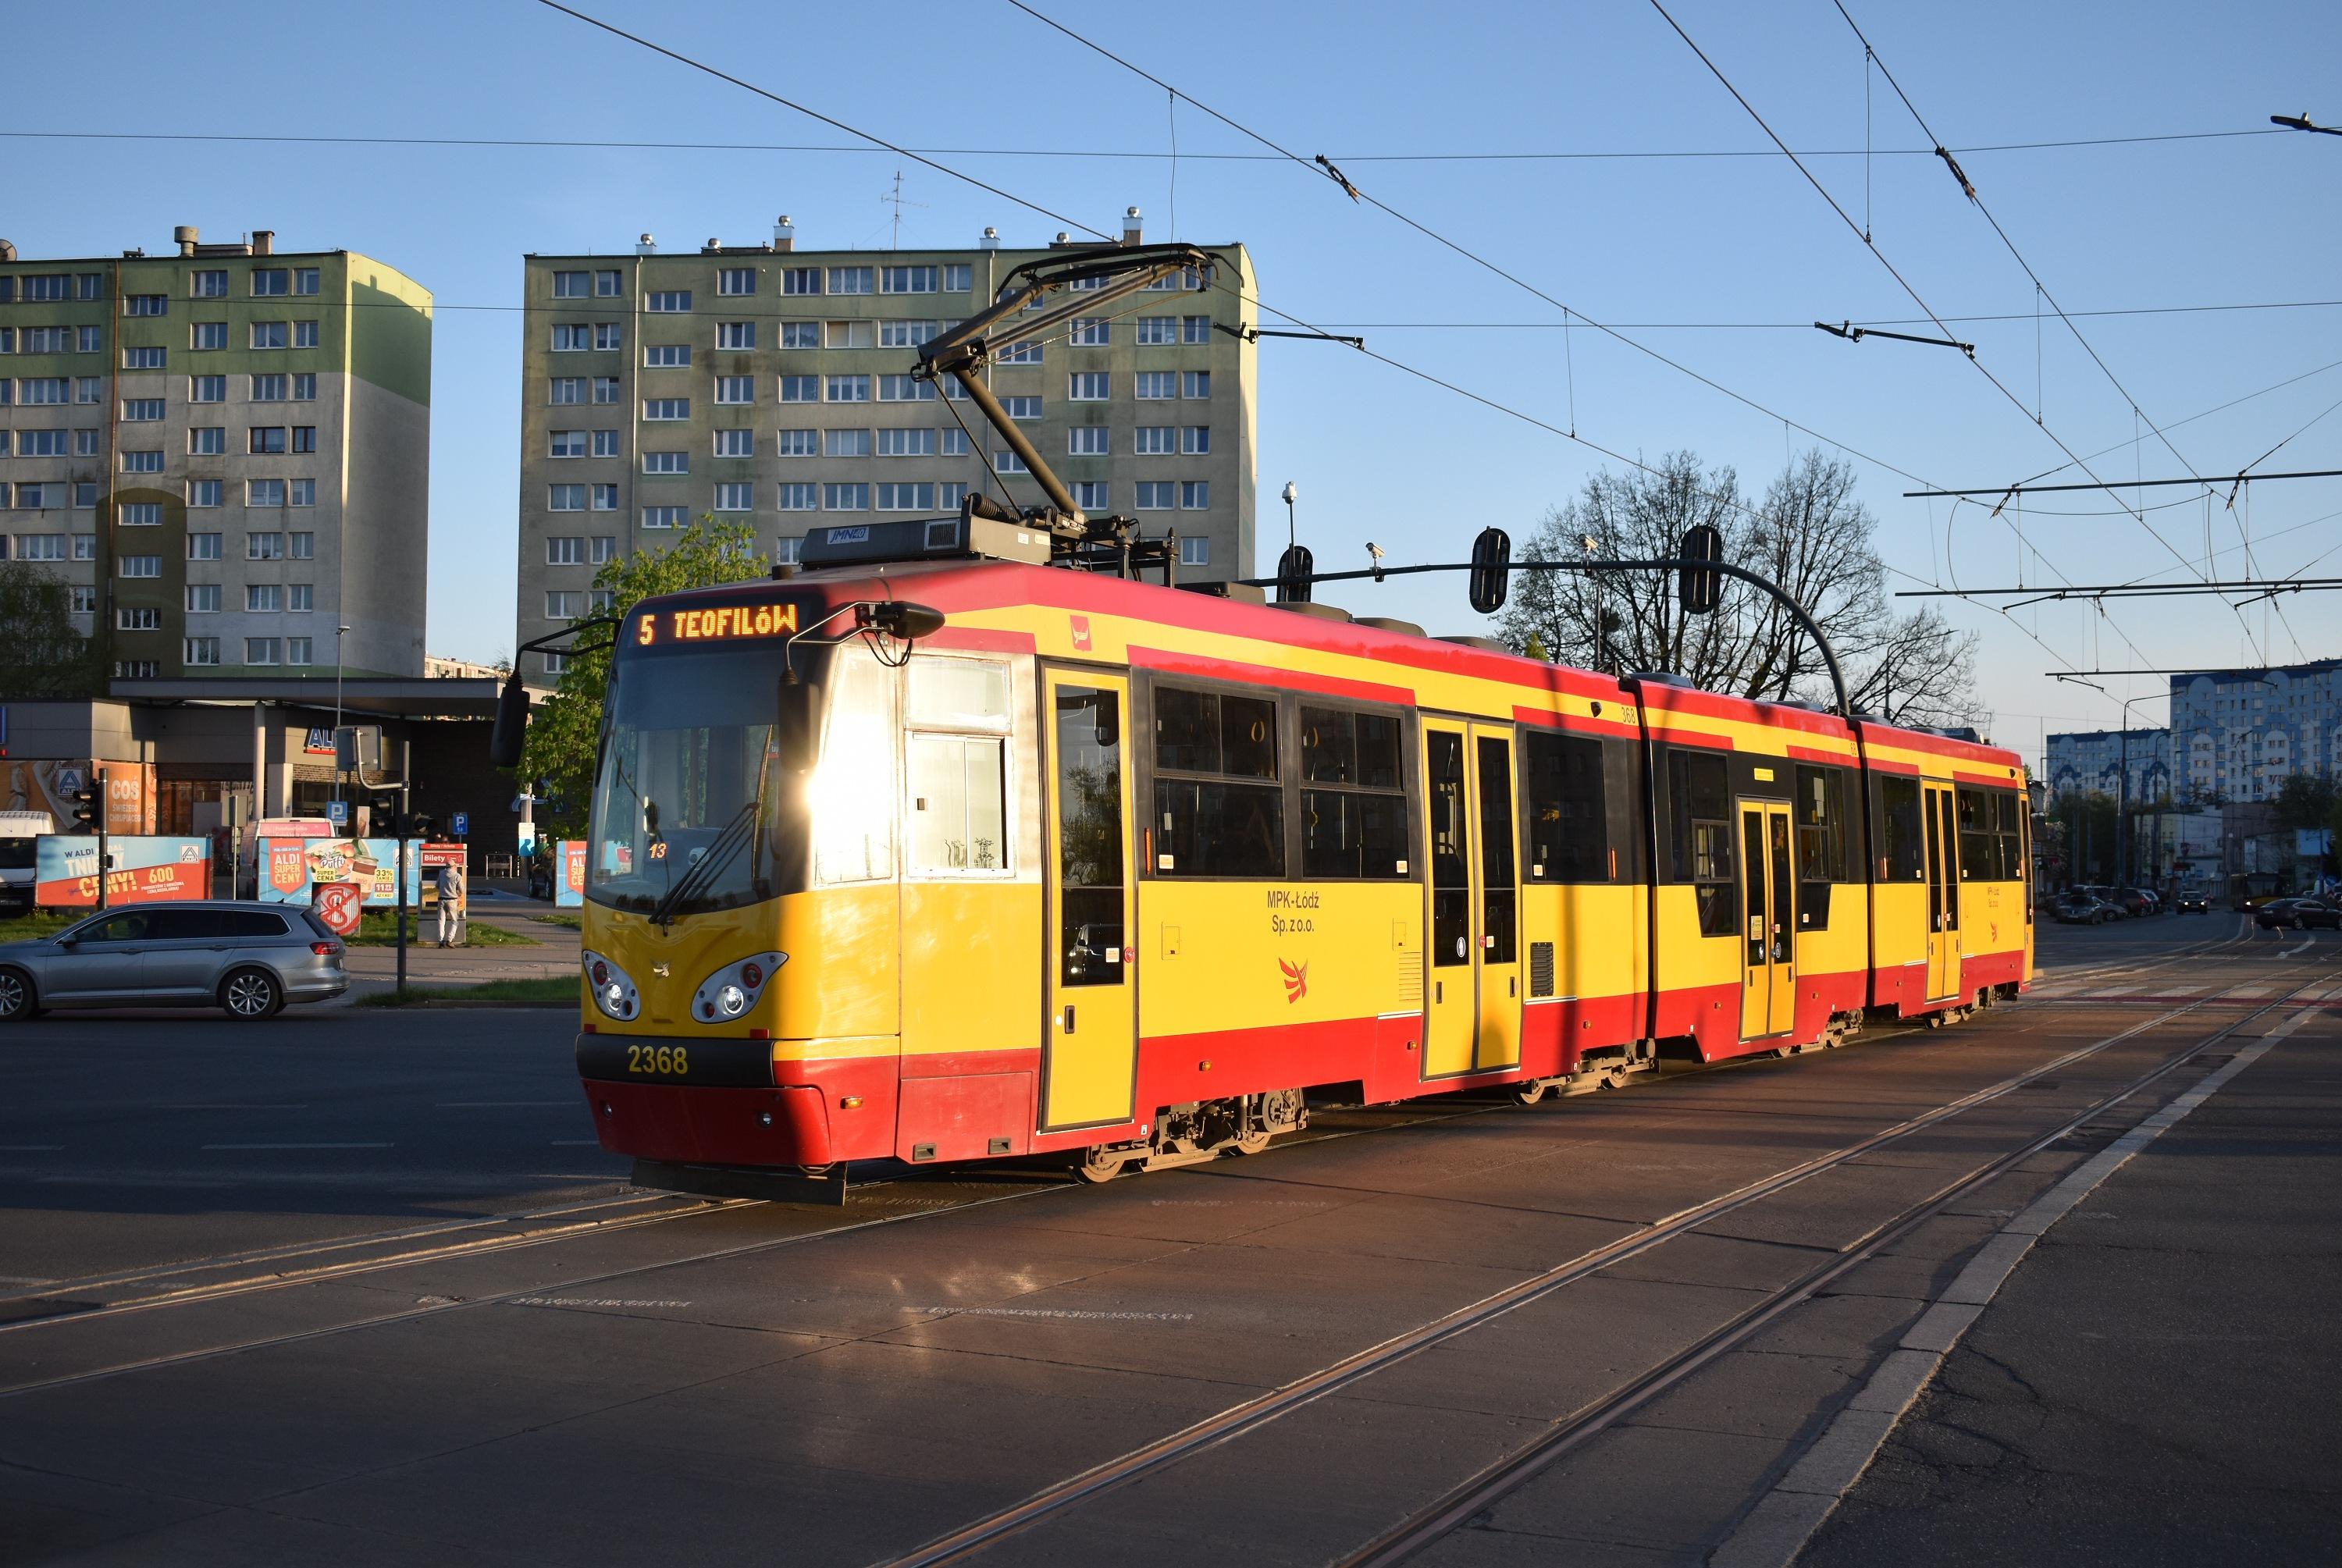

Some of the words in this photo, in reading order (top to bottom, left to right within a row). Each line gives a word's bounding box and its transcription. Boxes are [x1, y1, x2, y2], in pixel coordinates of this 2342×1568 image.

[640, 615, 655, 645] 5
[306, 726, 336, 748] AL
[112, 776, 140, 800] COŚ
[331, 804, 343, 820] P
[76, 848, 94, 857] ALDI
[424, 854, 446, 863] Bilety
[649, 843, 667, 859] 13
[275, 854, 300, 865] ALDI
[571, 856, 586, 867] AL
[149, 866, 174, 884] 600
[275, 864, 300, 873] SUPER
[275, 873, 300, 884] CENY
[571, 875, 585, 886] CE
[1267, 891, 1319, 908] MPK-Łódź
[1272, 914, 1288, 937] Sp.
[628, 1044, 689, 1075] 2368
